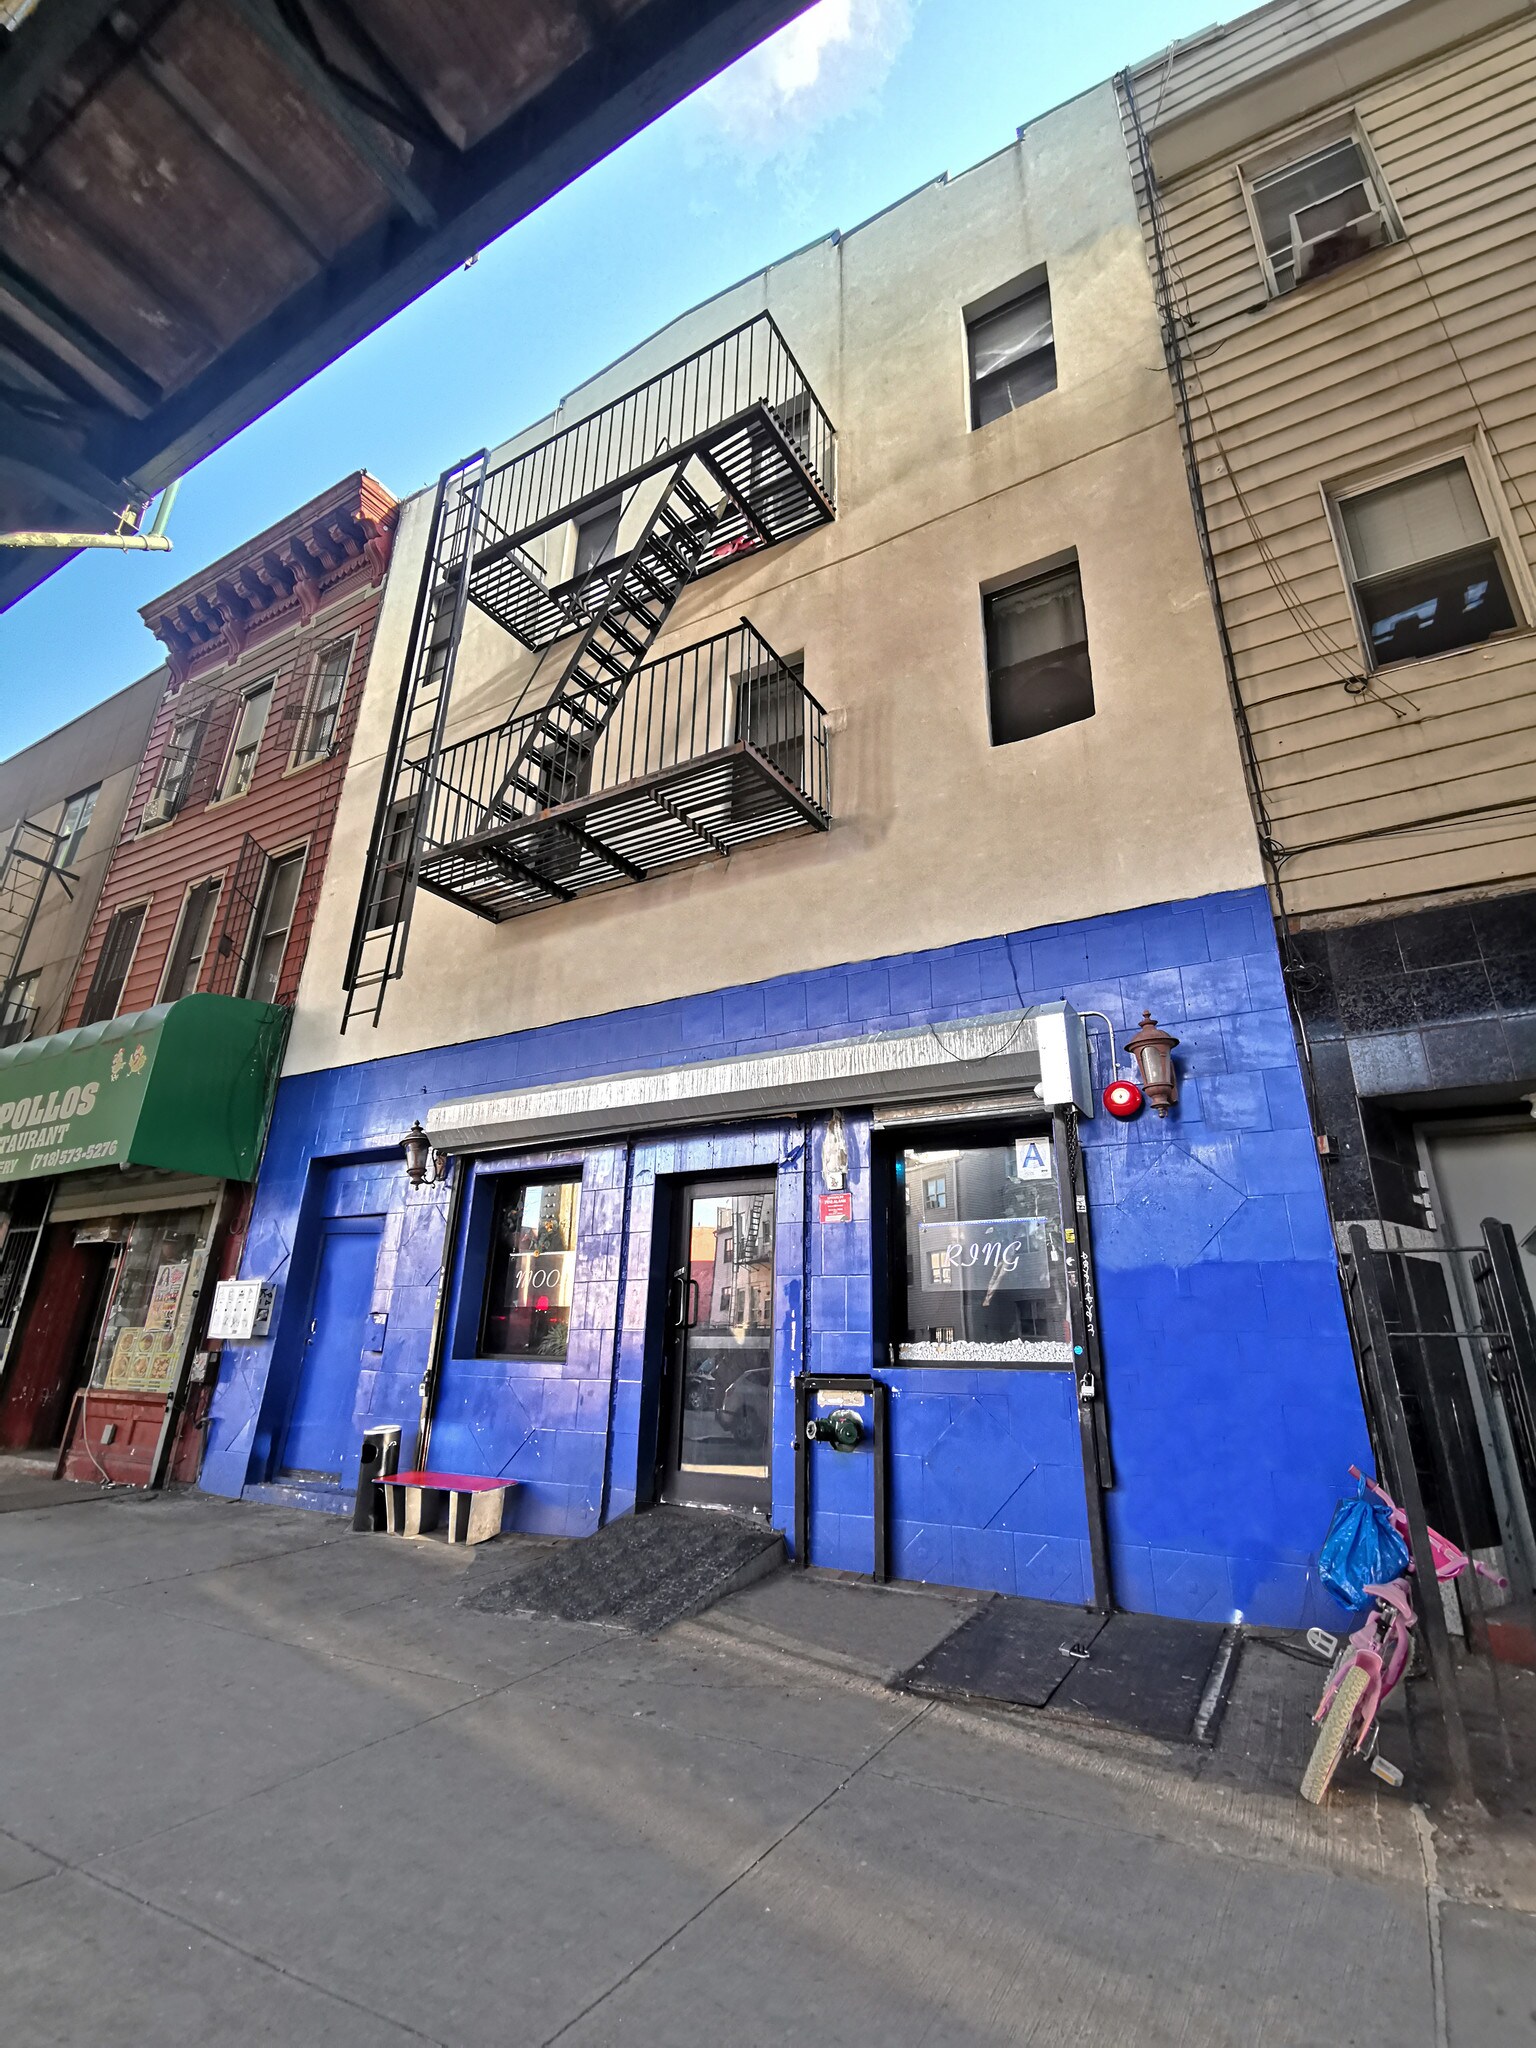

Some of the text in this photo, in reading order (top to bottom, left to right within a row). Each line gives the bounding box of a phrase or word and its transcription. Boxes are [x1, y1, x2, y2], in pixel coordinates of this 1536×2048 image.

[0, 1082, 100, 1130] POLLOS
[1022, 1142, 1046, 1168] A
[946, 1241, 1022, 1272] RING
